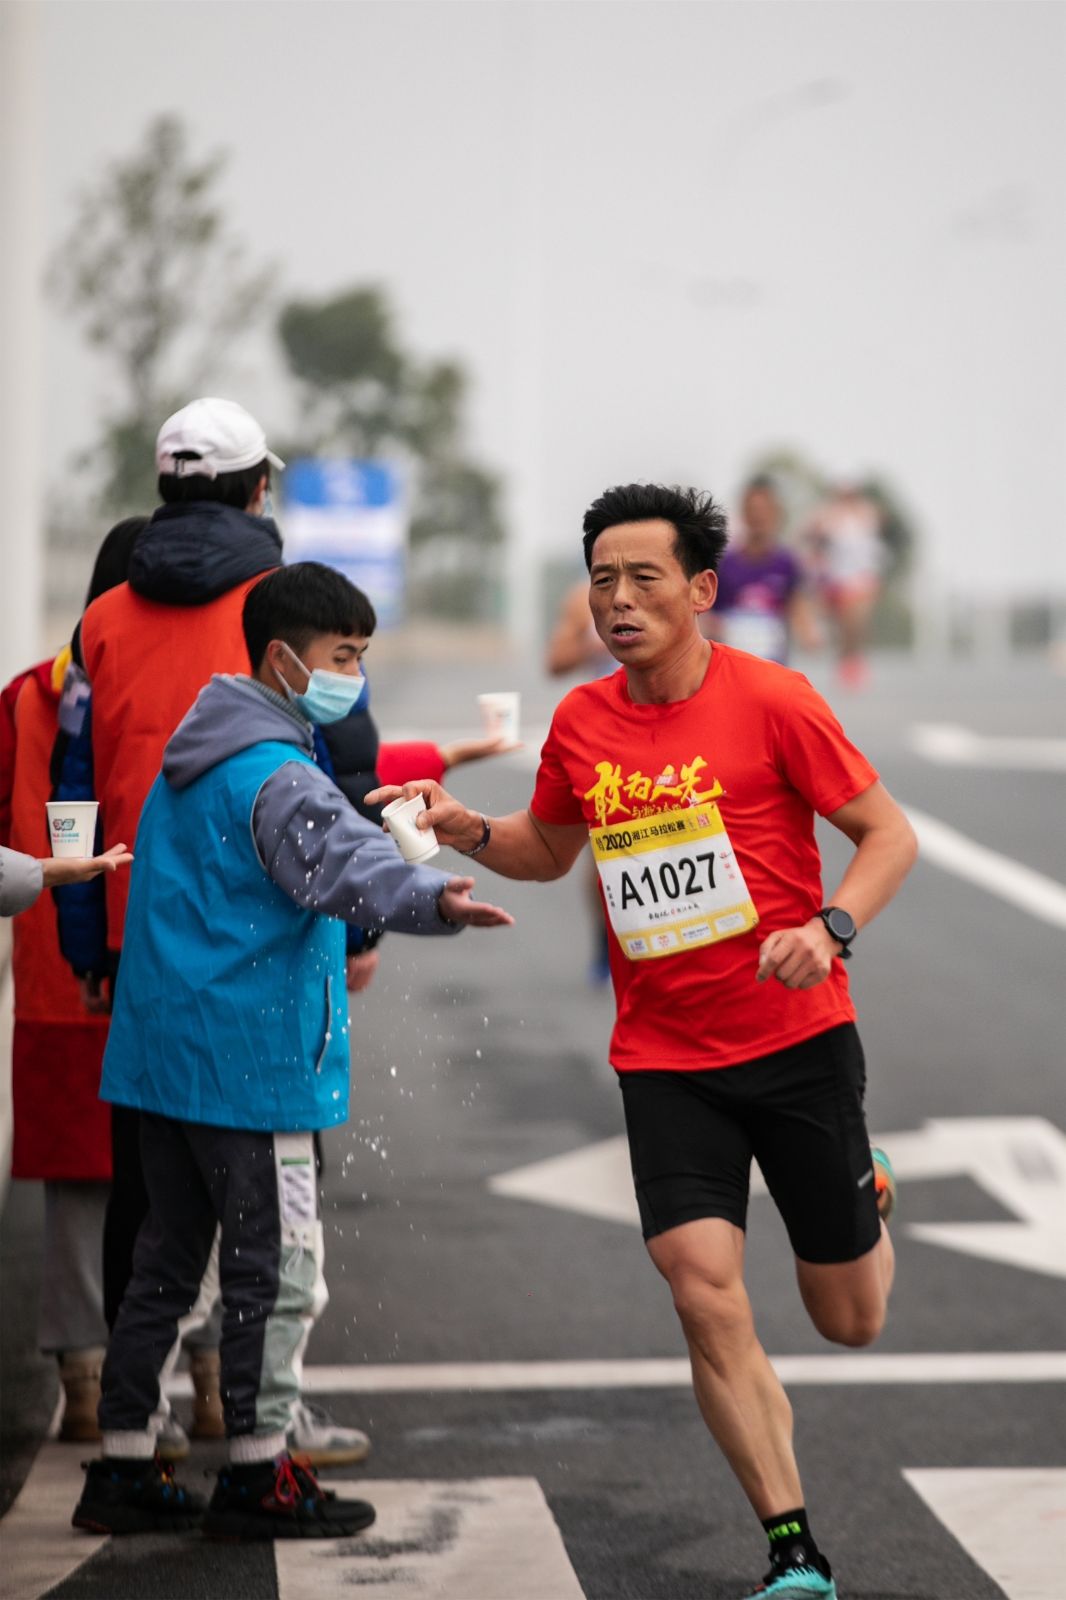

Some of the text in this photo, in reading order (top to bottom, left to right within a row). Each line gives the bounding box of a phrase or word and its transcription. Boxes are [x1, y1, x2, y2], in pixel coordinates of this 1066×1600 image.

[584, 755, 723, 825] 敢为人先
[621, 852, 717, 910] A1027
